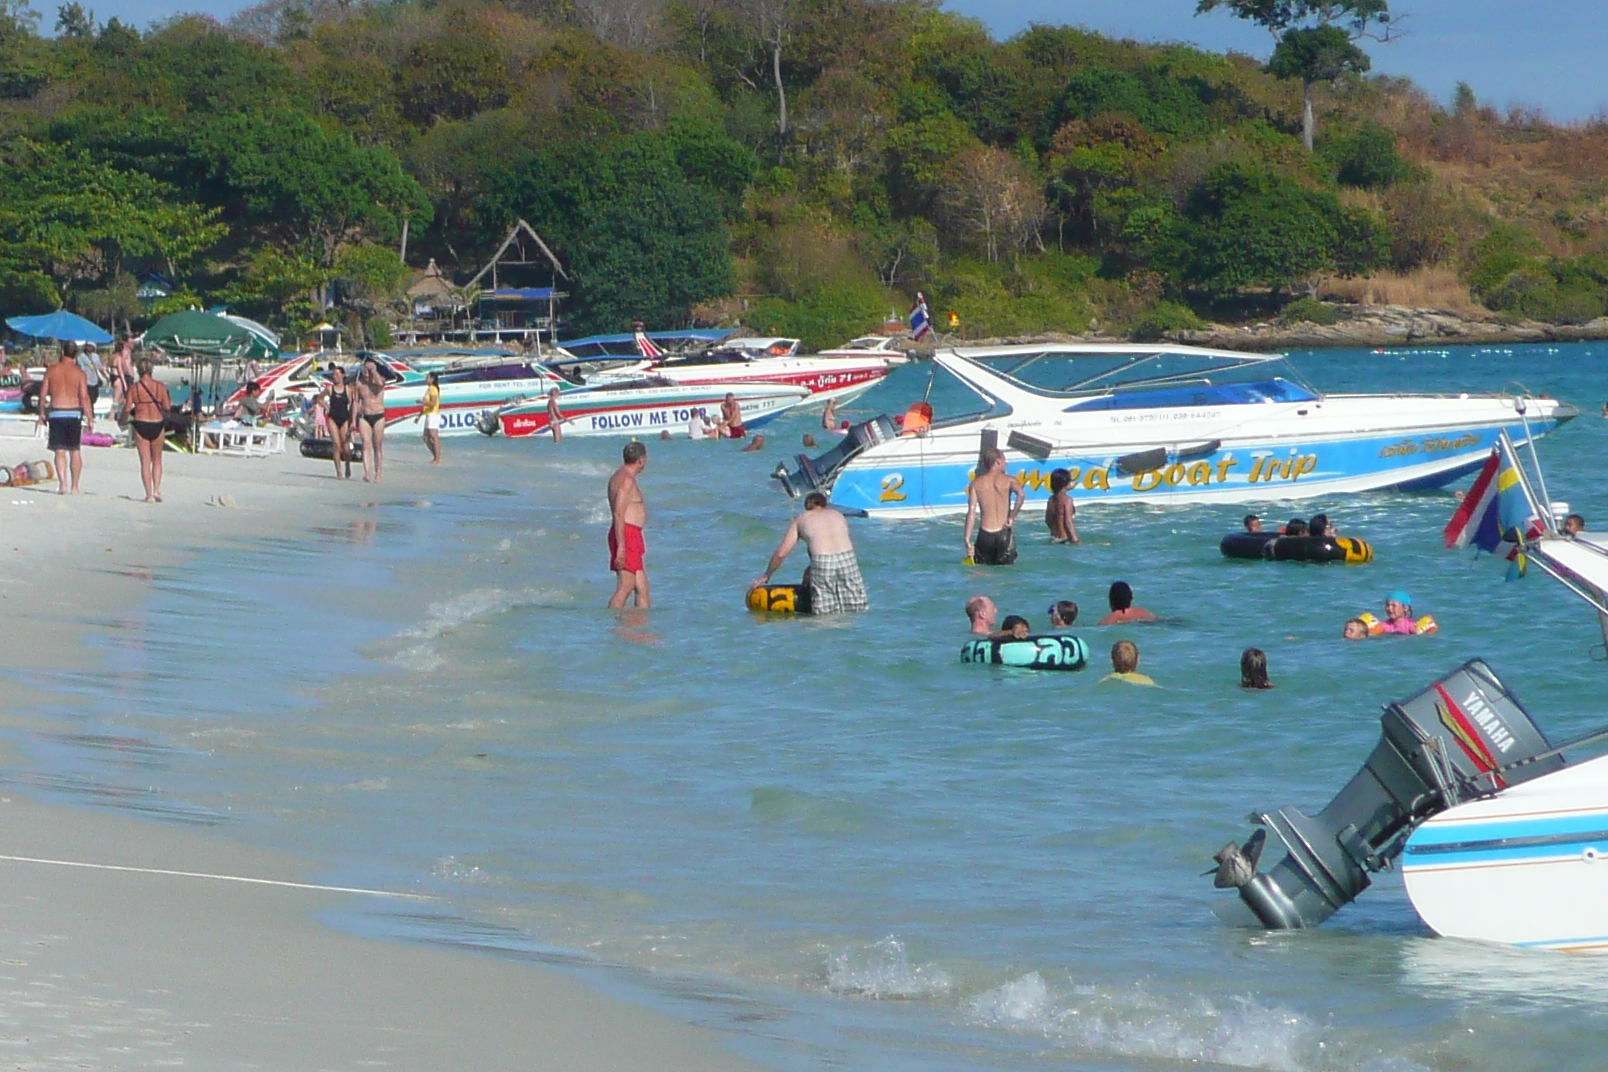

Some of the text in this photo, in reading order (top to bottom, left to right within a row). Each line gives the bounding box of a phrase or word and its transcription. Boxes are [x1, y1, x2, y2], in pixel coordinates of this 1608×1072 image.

[438, 412, 486, 429] OLLO
[591, 407, 707, 429] FOLLOW ME TOR
[1248, 447, 1318, 482] Trip
[879, 472, 907, 503] 2
[1462, 691, 1515, 754] YAMAHA
